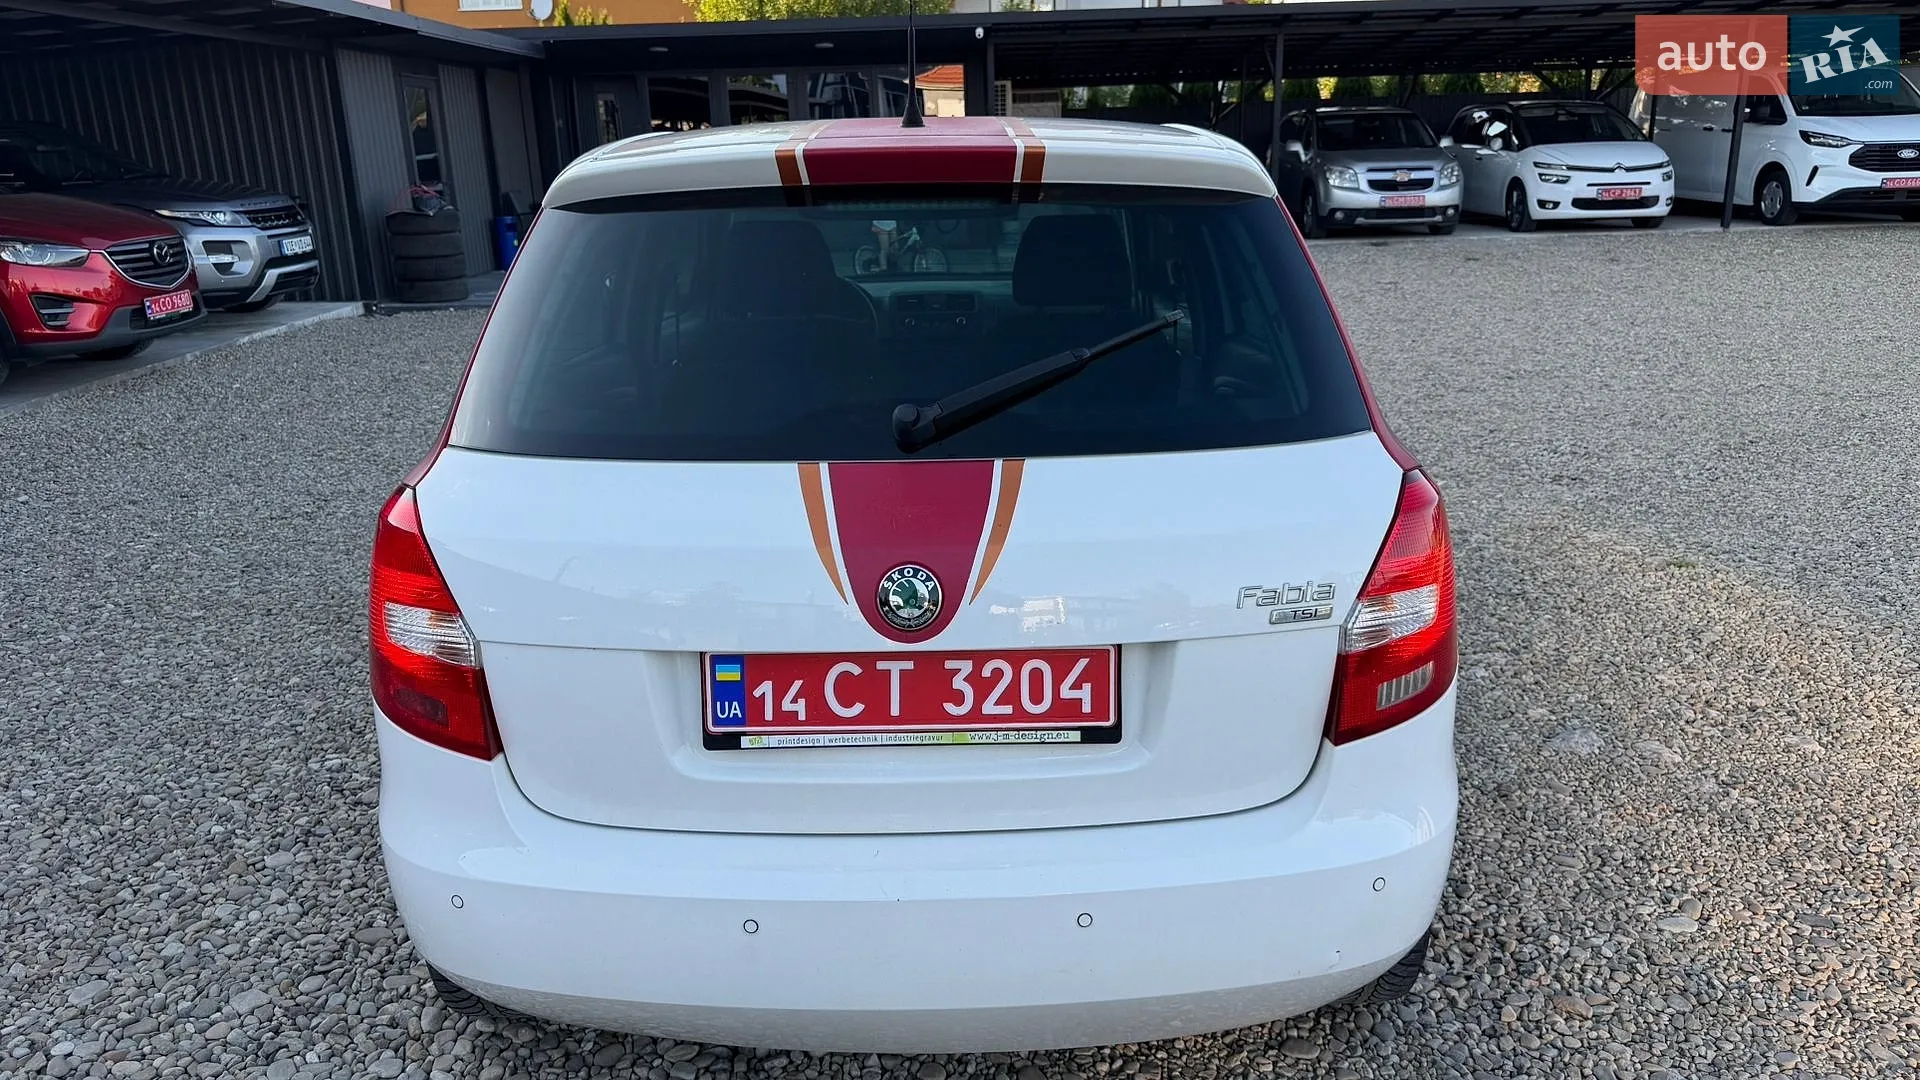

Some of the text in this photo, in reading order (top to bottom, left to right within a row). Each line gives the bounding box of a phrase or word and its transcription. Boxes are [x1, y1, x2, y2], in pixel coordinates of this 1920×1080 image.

[151, 292, 190, 313] 14 CO 9680
[1236, 580, 1336, 609] Fabia
[1290, 608, 1318, 620] TSI
[752, 657, 1092, 721] 14 CT 3204
[716, 701, 742, 719] UA
[777, 736, 821, 746] printdesign
[828, 734, 878, 744] werbetechnik
